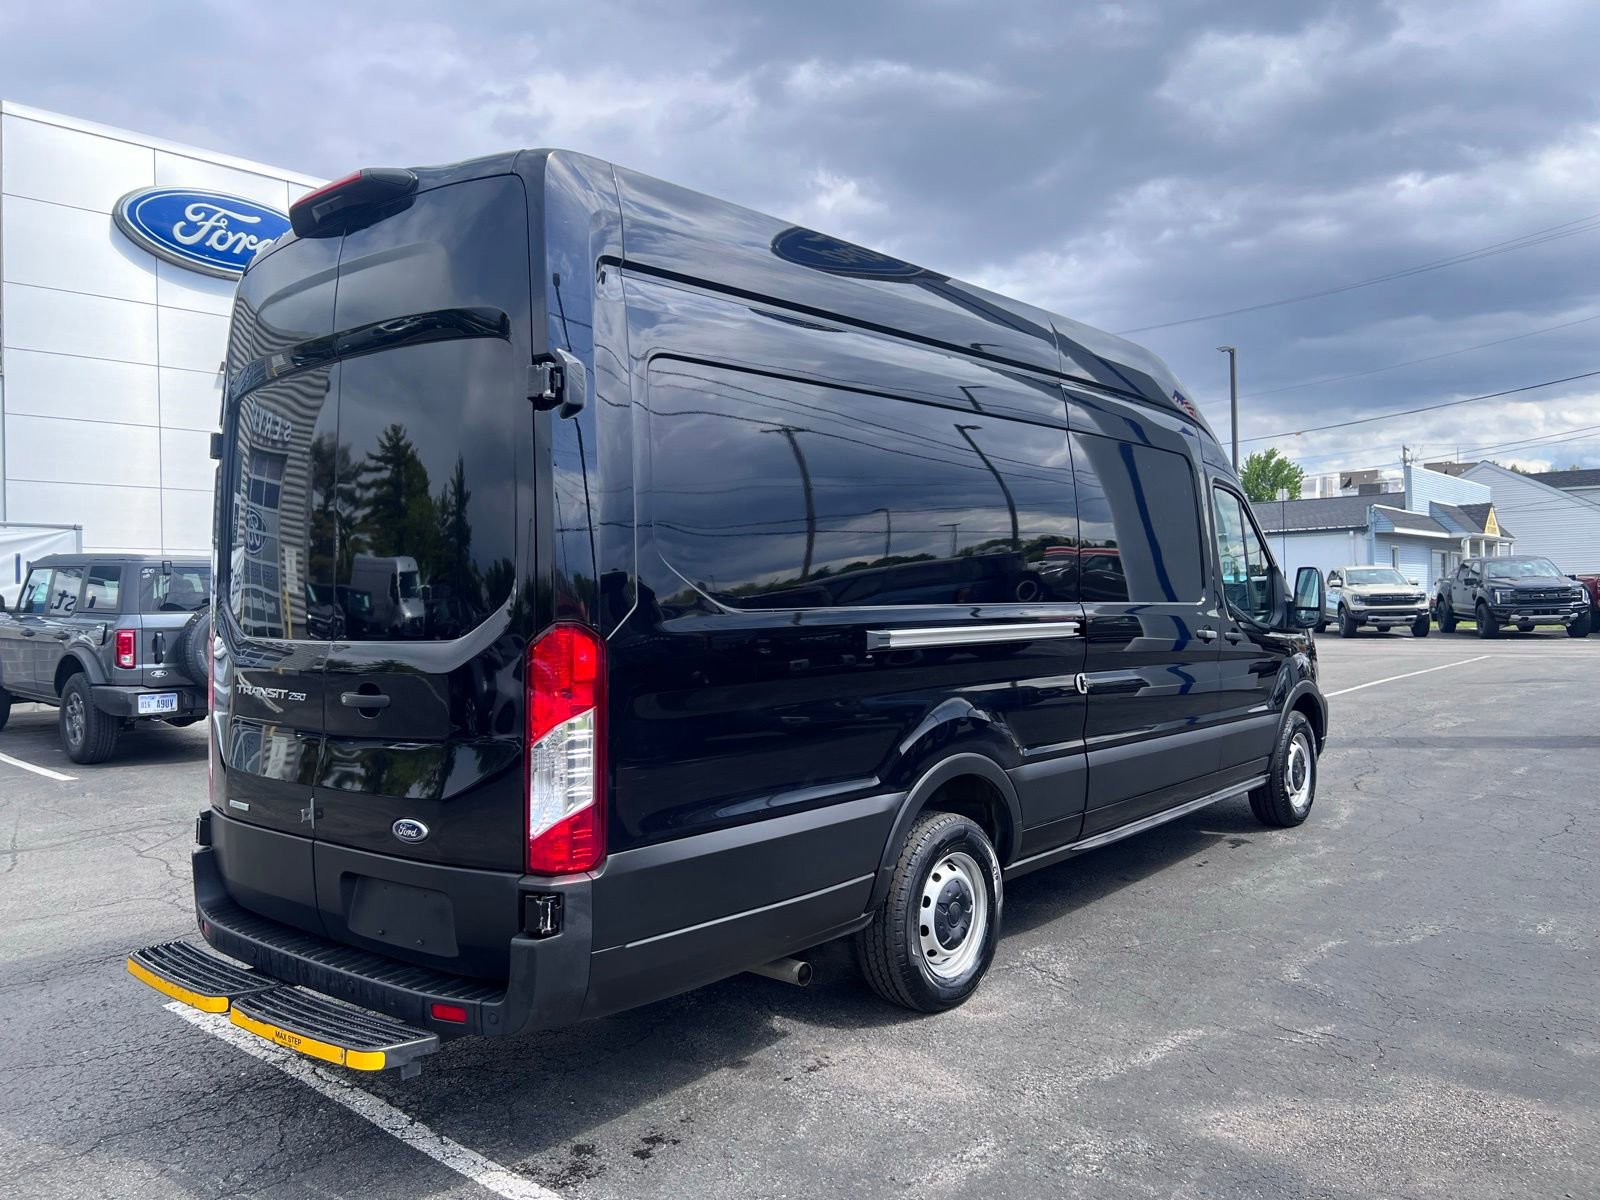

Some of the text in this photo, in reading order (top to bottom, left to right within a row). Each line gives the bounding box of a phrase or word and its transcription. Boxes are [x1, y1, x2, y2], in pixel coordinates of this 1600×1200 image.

[236, 684, 306, 701] TRANSIT 250
[398, 823, 418, 837] Ford
[275, 1031, 287, 1040] MAX
[287, 1035, 302, 1045] STEP
